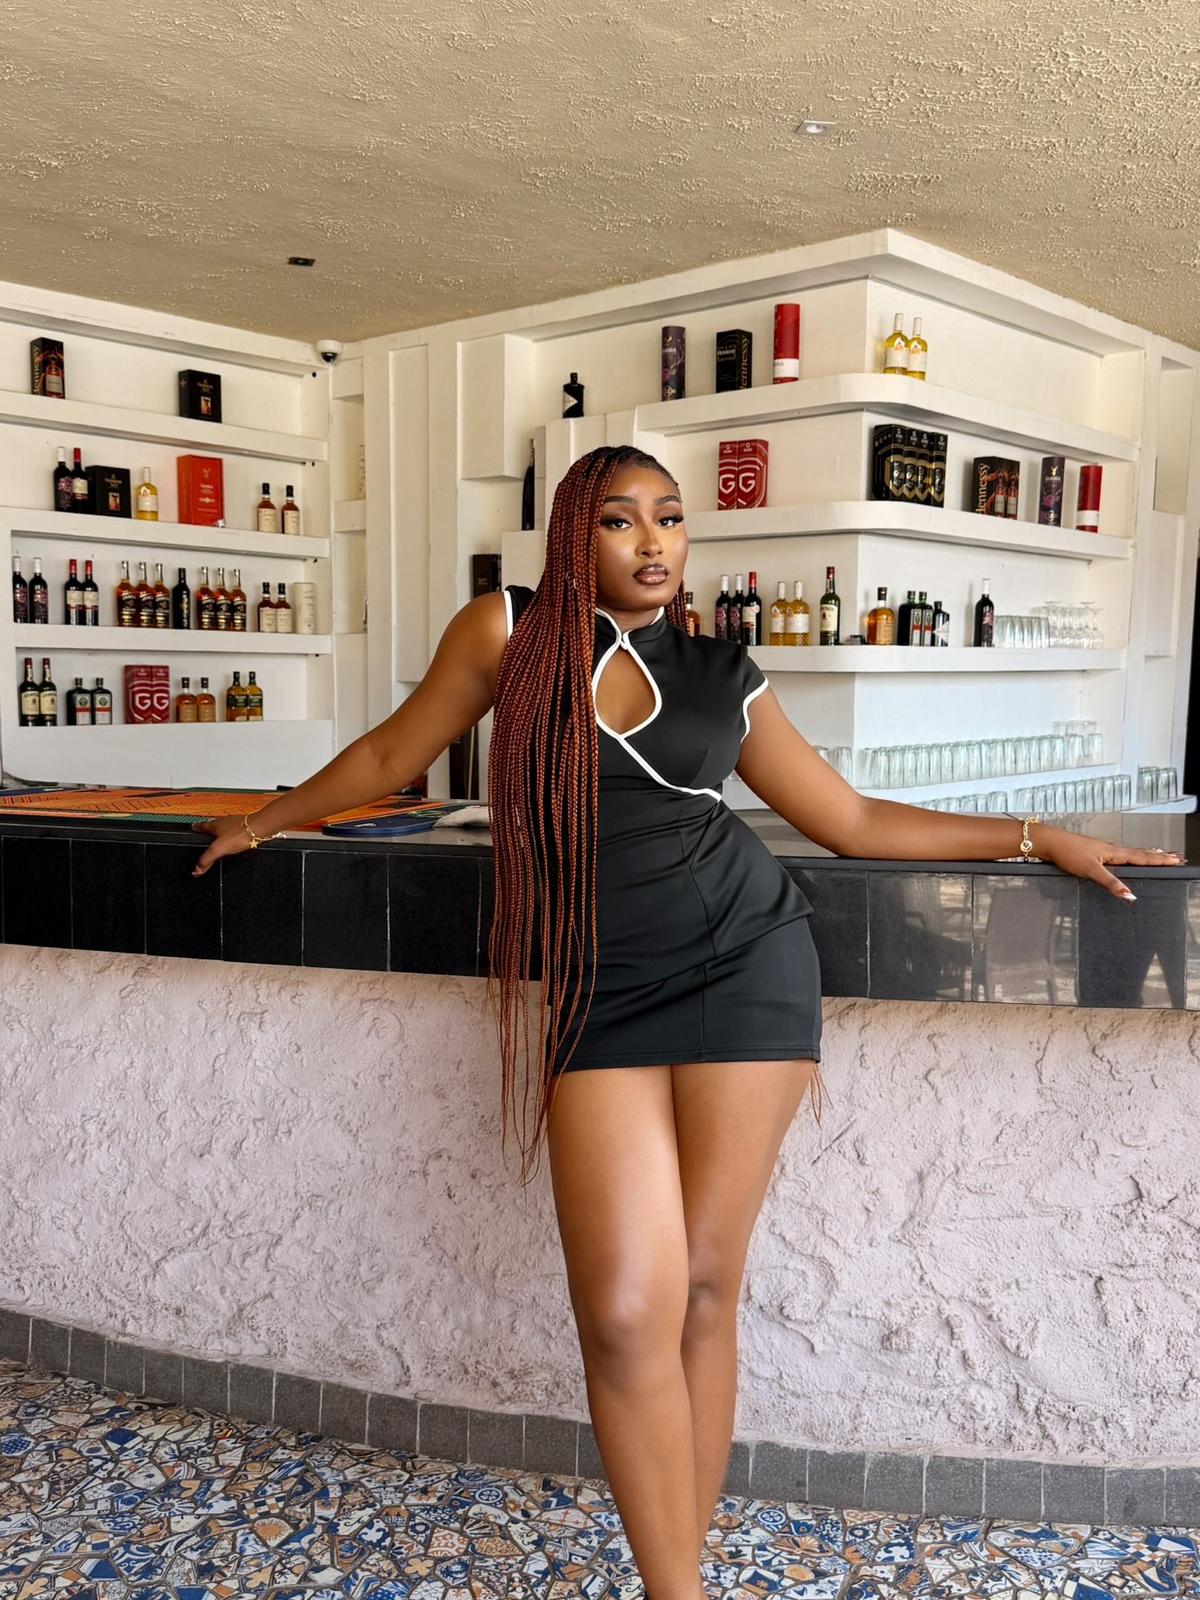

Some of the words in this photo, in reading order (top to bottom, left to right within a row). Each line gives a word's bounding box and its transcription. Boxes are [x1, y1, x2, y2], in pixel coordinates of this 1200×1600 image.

[739, 335, 749, 389] ennessy
[719, 474, 736, 494] G
[738, 472, 756, 493] G
[135, 692, 151, 710] G
[153, 692, 169, 710] G
